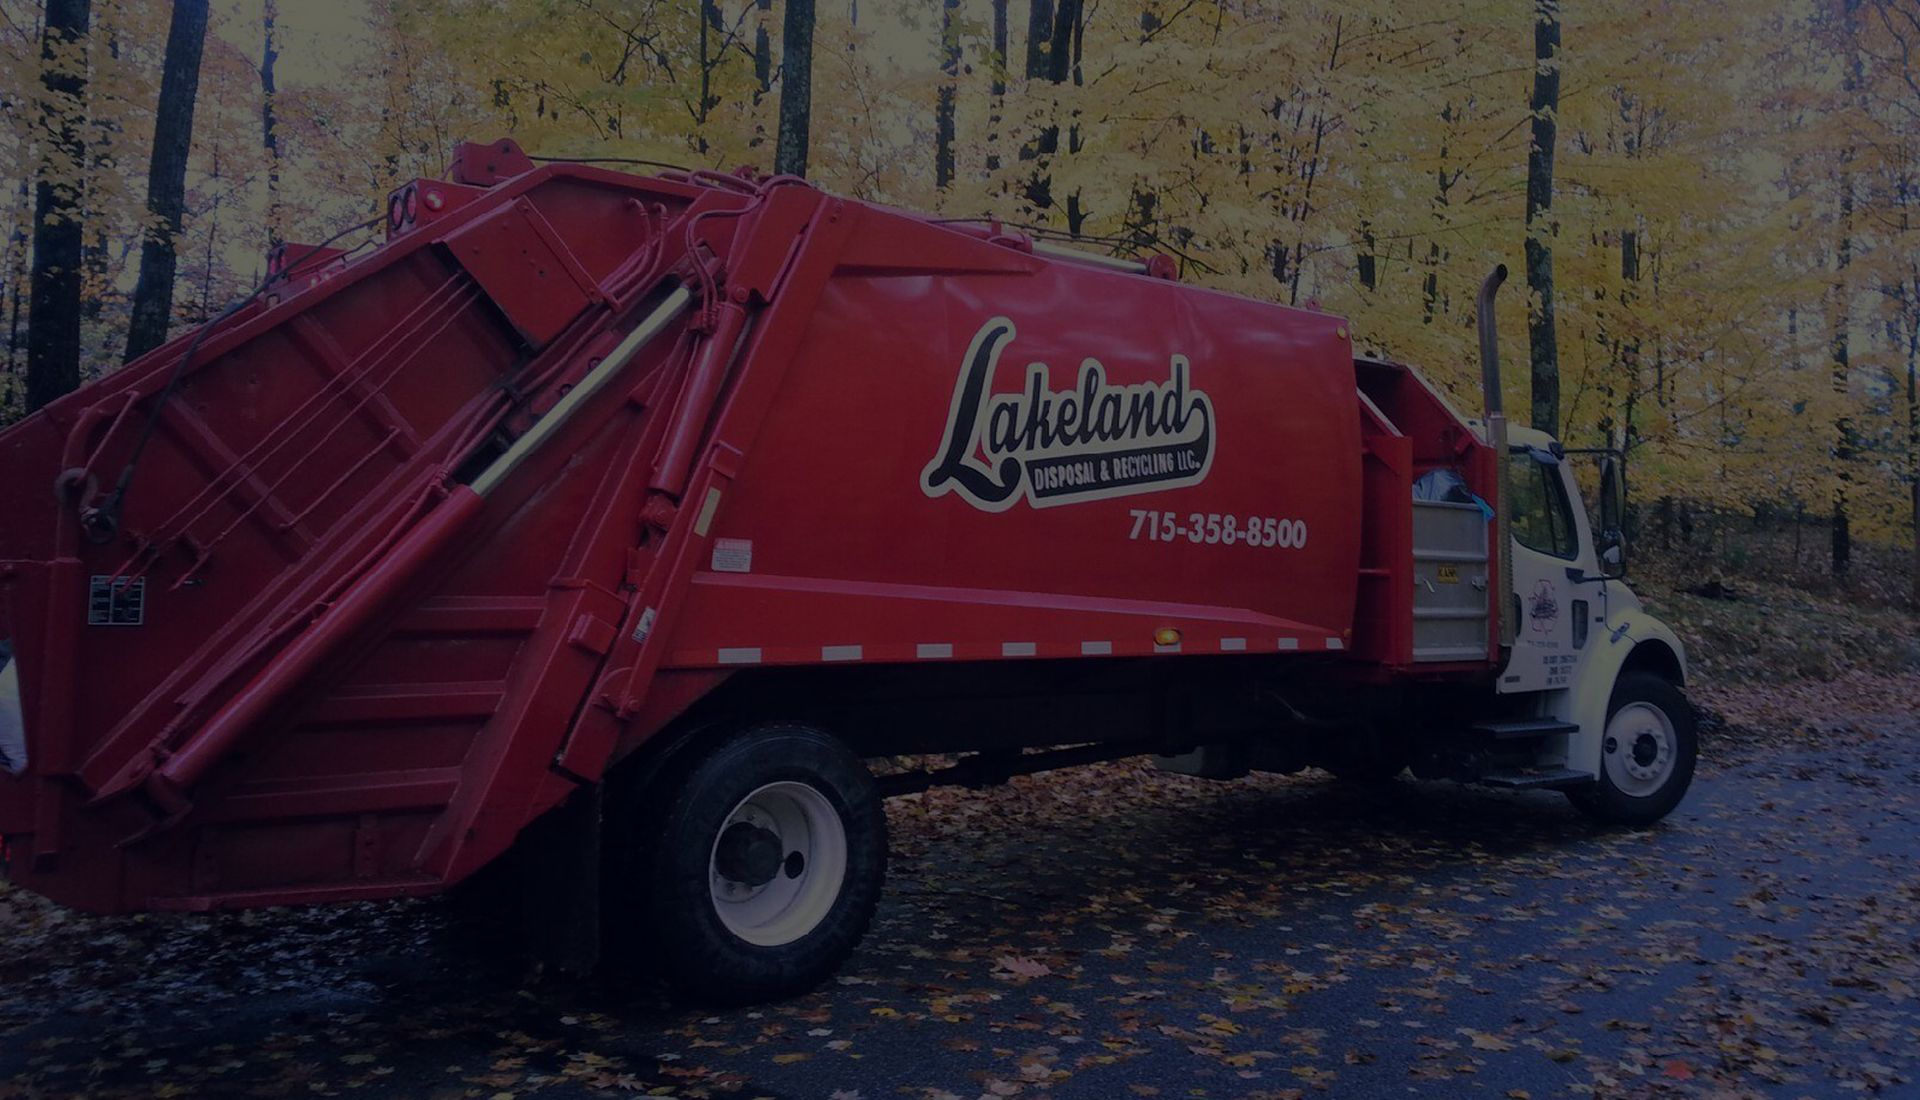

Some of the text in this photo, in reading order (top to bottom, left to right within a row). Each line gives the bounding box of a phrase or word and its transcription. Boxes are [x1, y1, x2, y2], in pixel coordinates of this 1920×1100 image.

[926, 322, 1211, 504] Lakeland
[1034, 461, 1097, 491] DISPOSAL
[1100, 459, 1111, 482] &
[1113, 452, 1174, 480] RECYCLING
[1129, 509, 1308, 550] 715-358-8500
